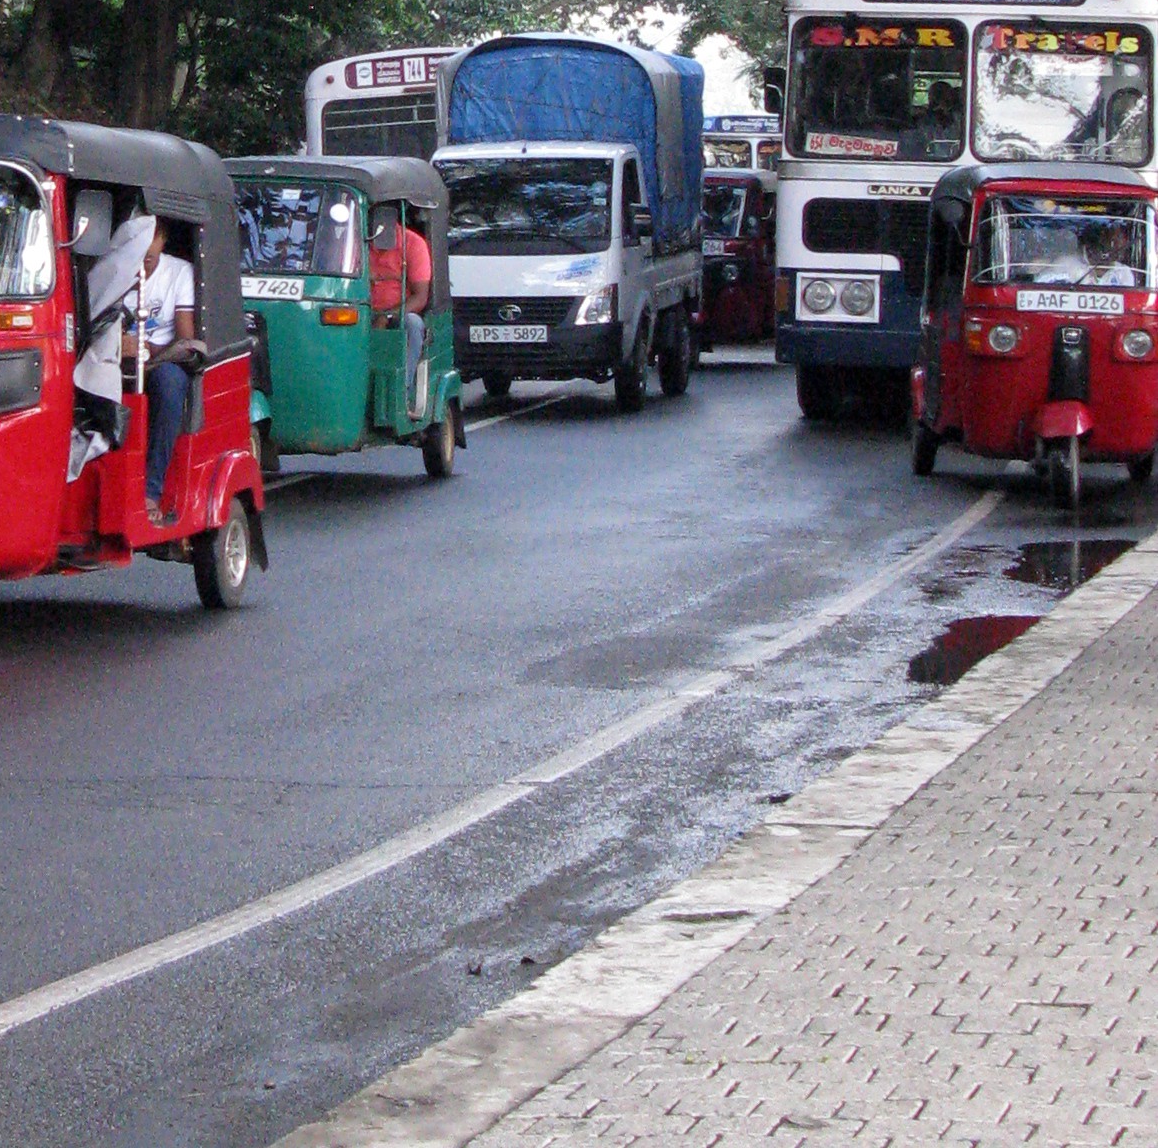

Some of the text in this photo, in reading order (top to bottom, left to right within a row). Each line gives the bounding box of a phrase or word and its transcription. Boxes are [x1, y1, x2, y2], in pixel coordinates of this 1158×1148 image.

[869, 185, 922, 196] LANKA
[257, 280, 299, 296] 7426
[1037, 293, 1069, 308] AAF
[1077, 295, 1120, 311] 0126
[483, 328, 499, 340] PS
[513, 328, 545, 340] 5892
